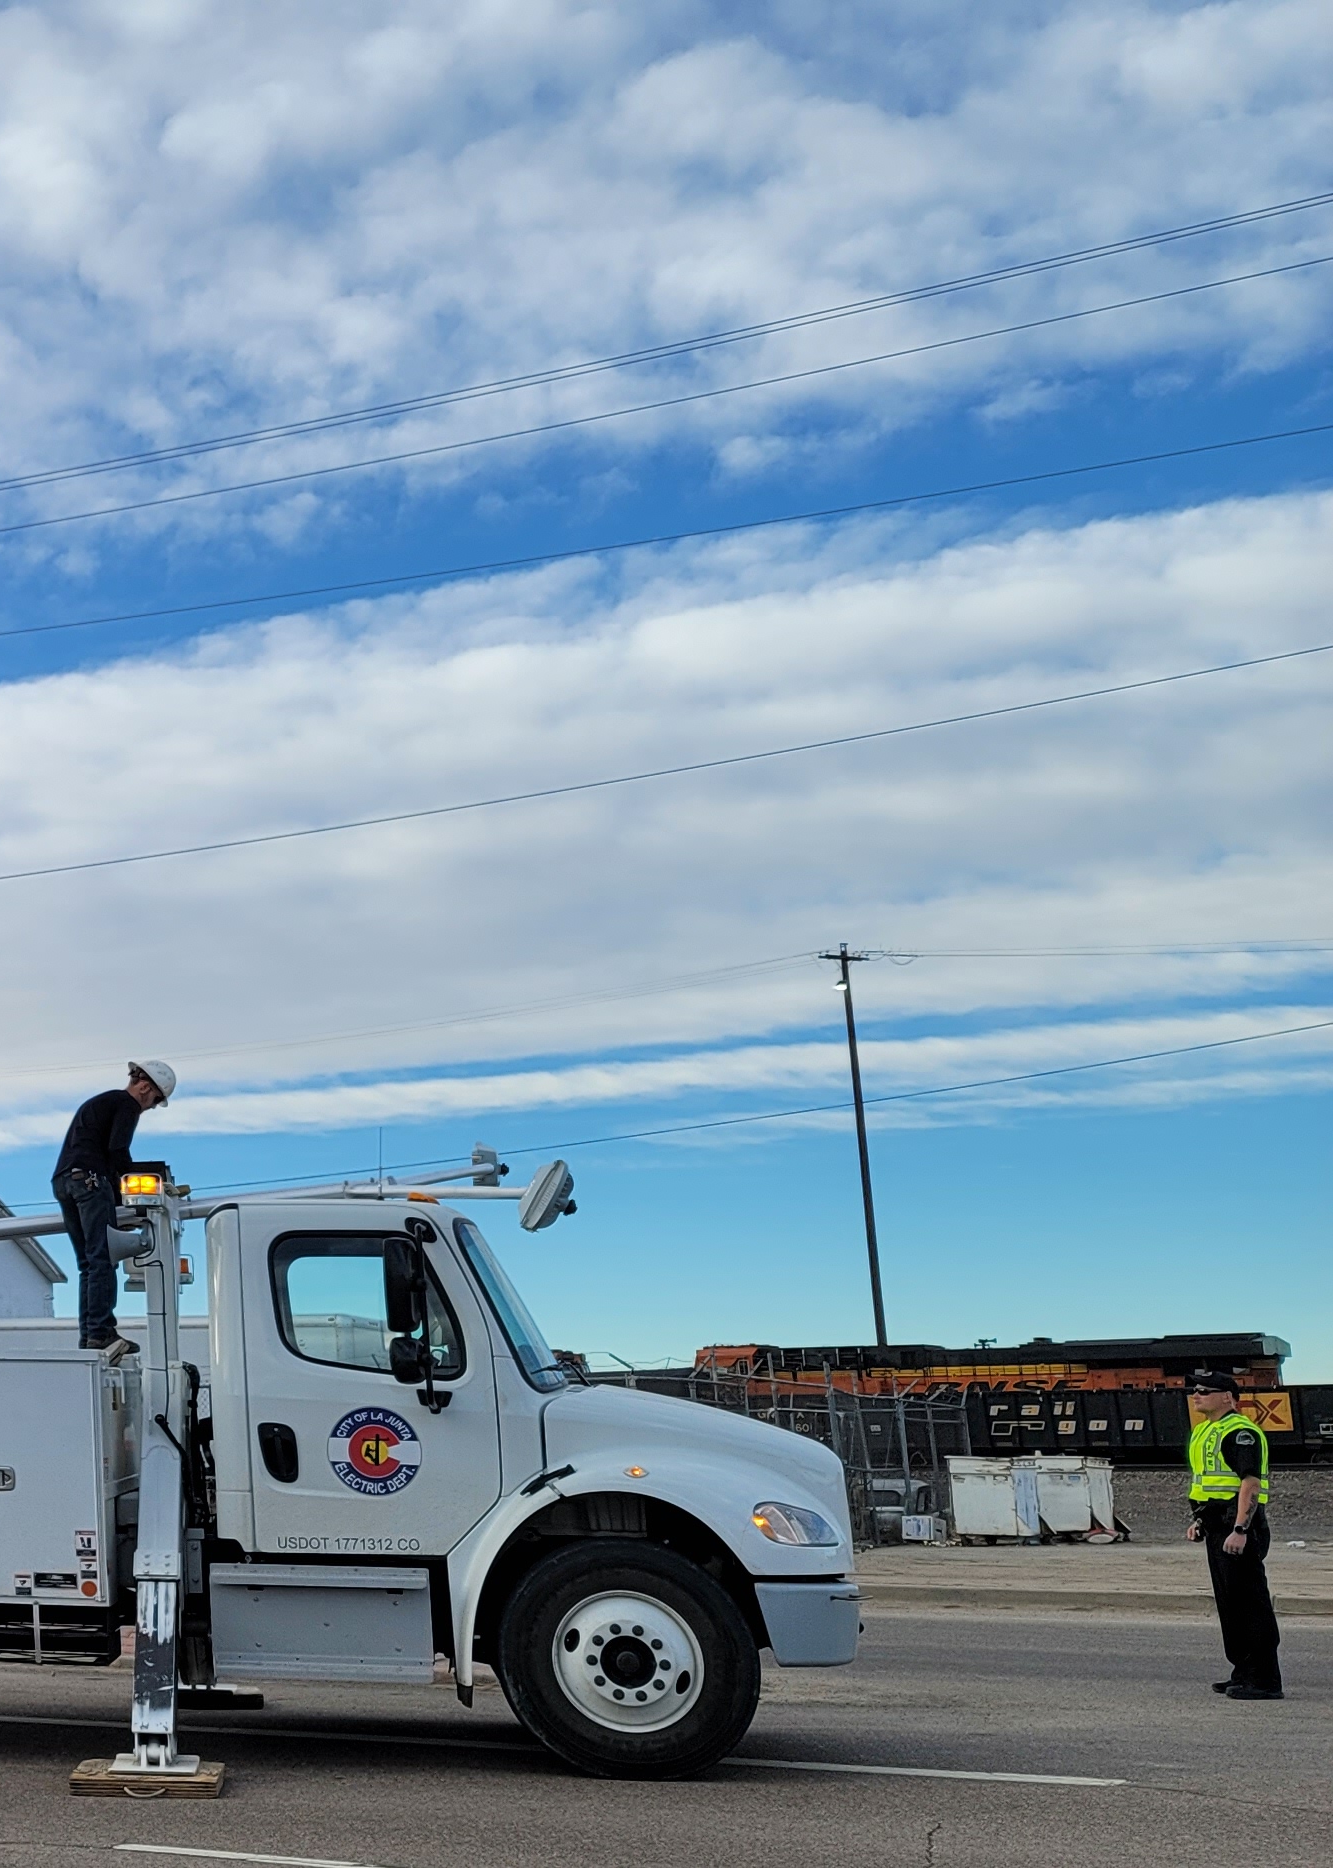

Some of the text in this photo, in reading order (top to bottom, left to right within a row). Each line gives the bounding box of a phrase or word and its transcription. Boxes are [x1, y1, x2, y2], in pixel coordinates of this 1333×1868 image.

[336, 1411, 412, 1440] CITY OF LA JUNTA
[335, 1462, 416, 1494] ELECTRIC DEPT.
[277, 1536, 421, 1551] USDOT 1771312 CO
